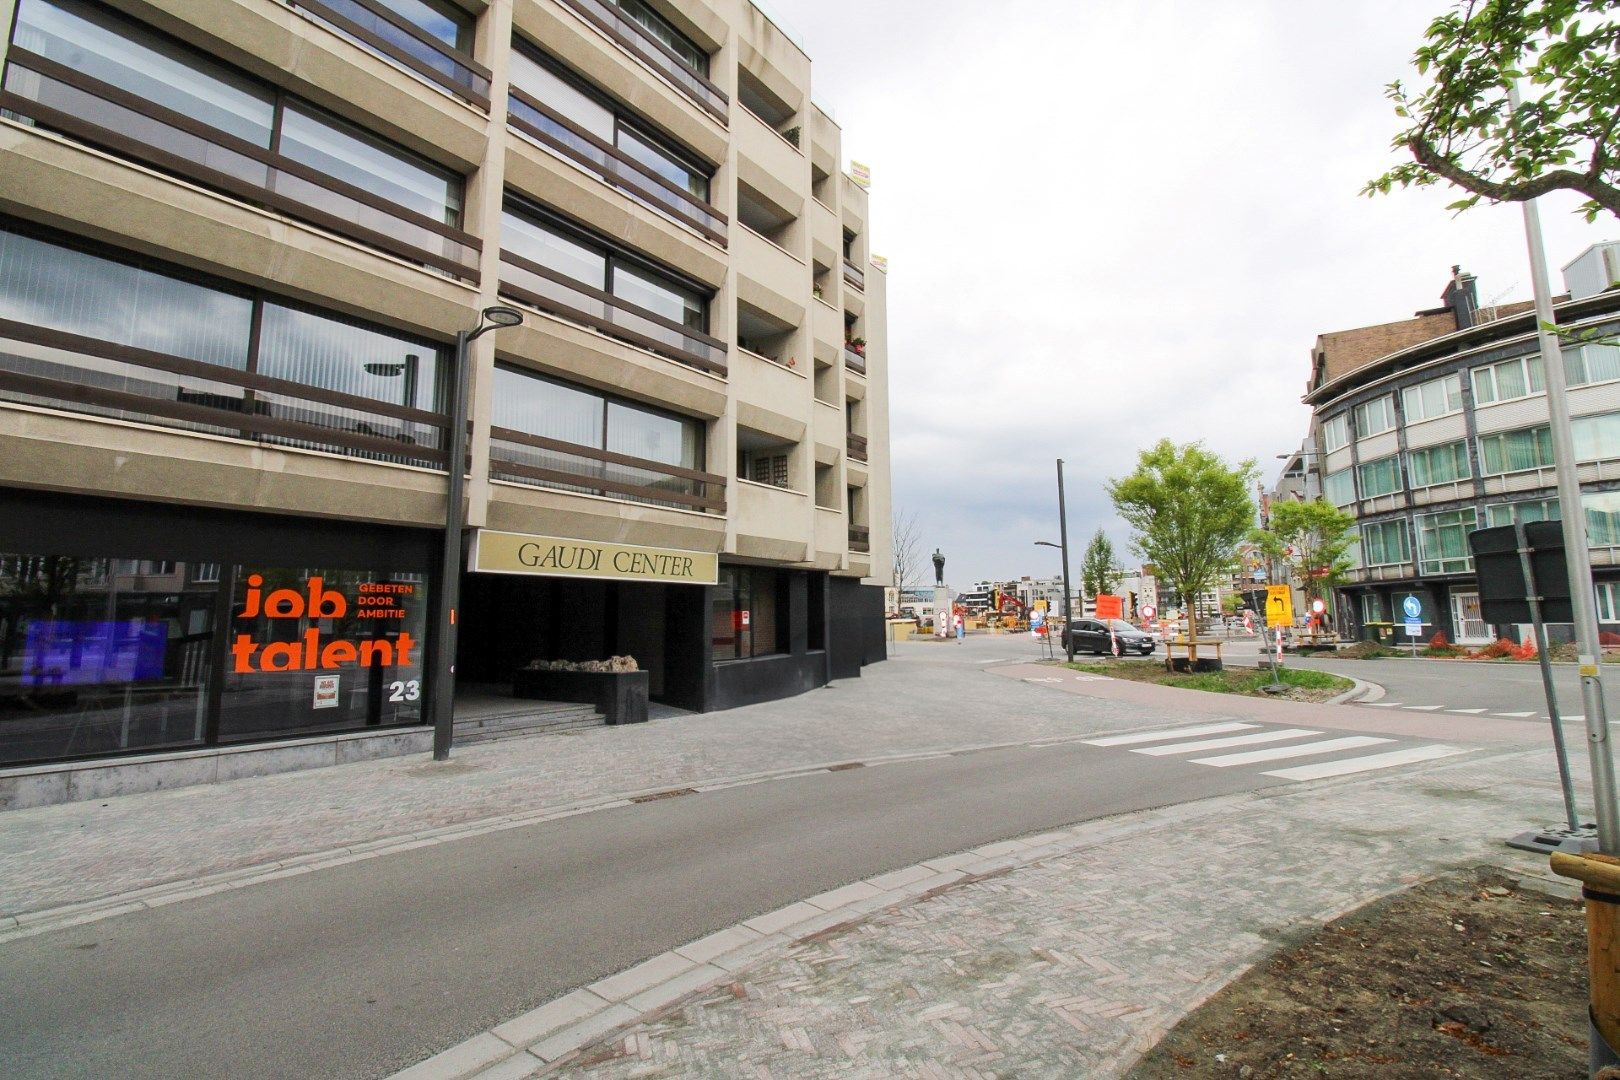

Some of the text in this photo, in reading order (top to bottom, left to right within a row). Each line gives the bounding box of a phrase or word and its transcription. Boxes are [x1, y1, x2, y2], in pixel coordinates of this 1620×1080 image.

[518, 543, 693, 577] GAUDI CENTER
[237, 574, 347, 618] job
[358, 583, 413, 594] GEBETEN
[357, 596, 394, 606] DOOR
[357, 609, 406, 619] AMBITIE
[232, 627, 416, 673] talent
[389, 680, 420, 702] 23
